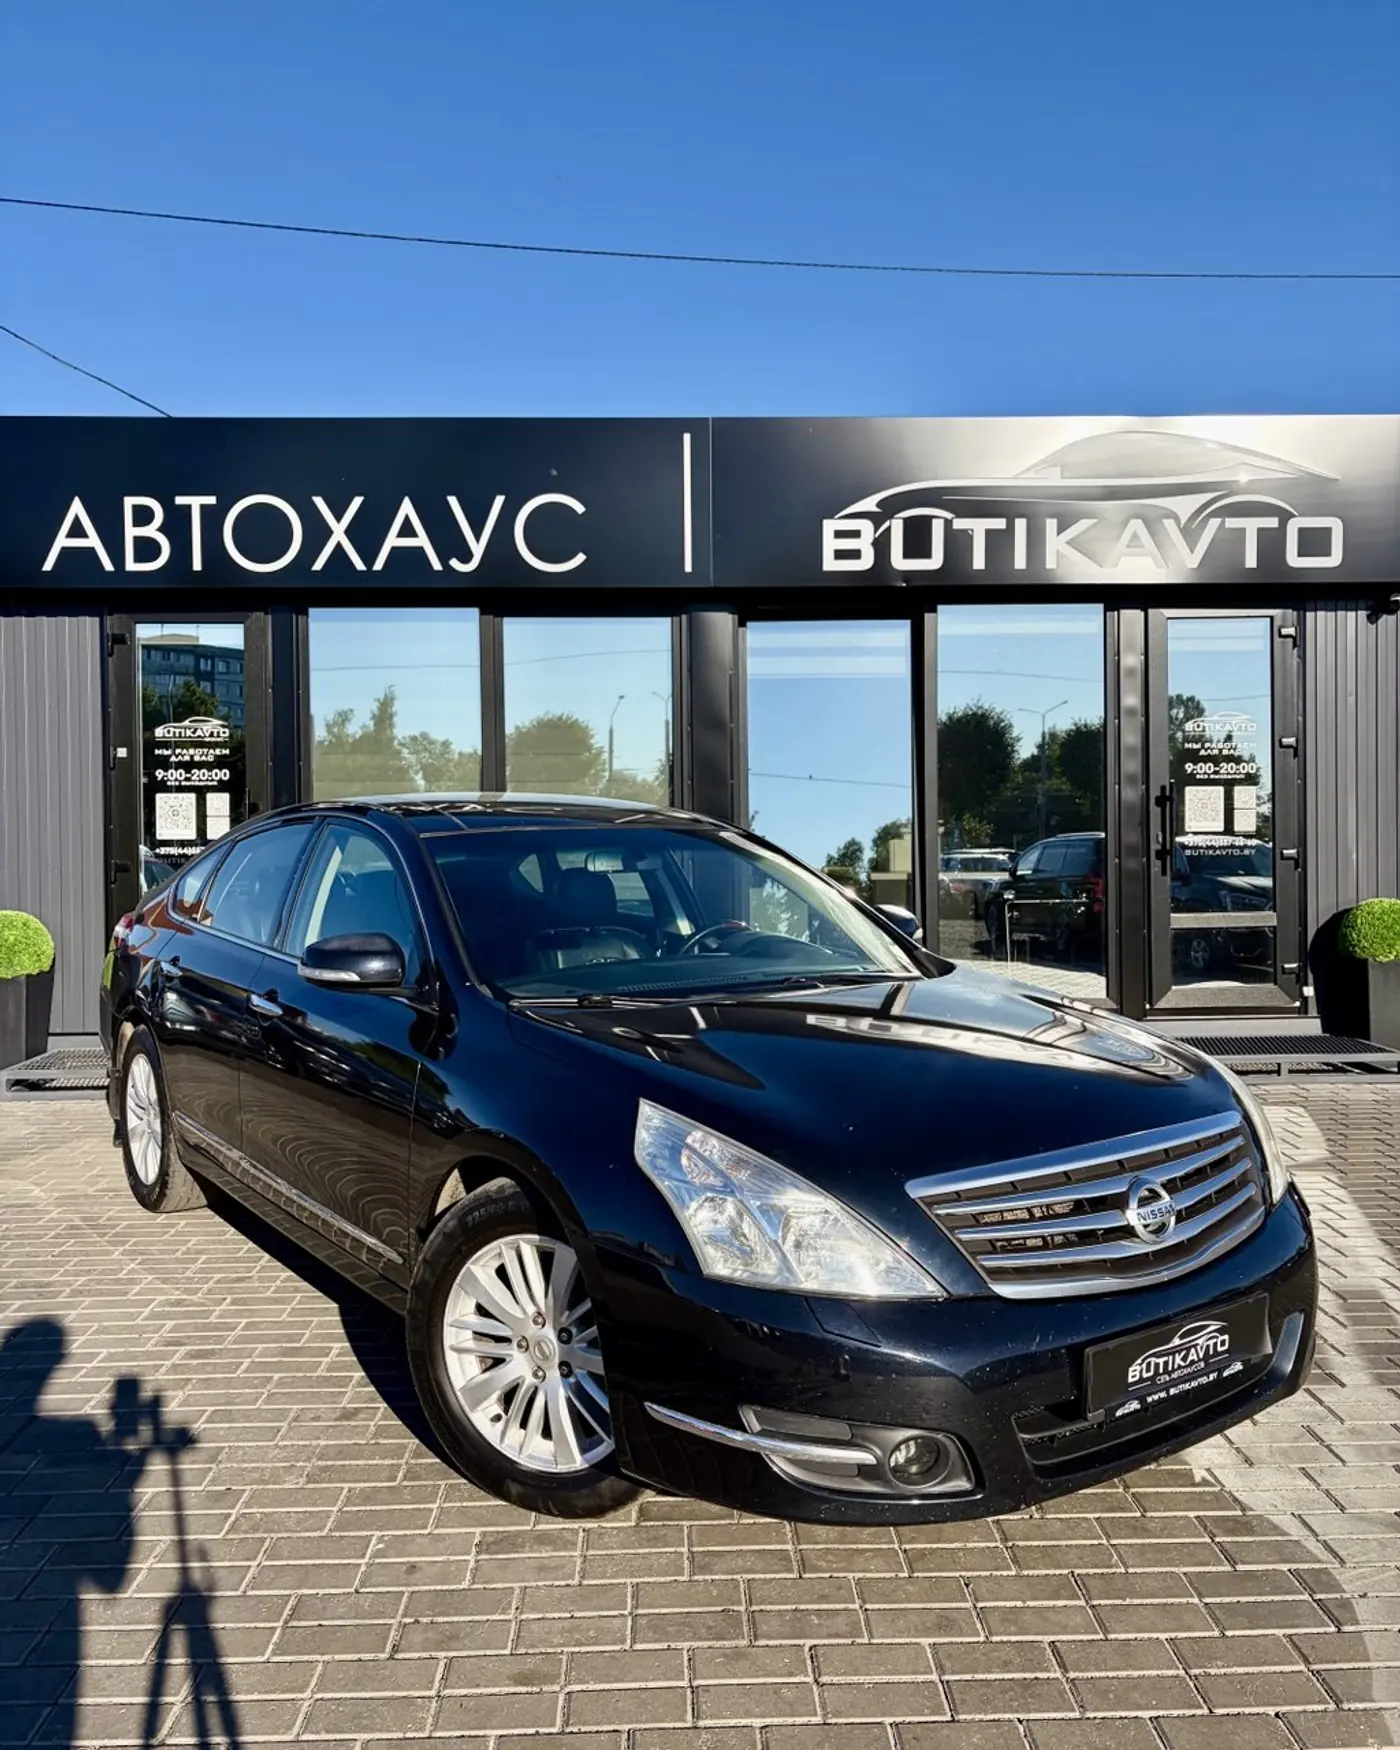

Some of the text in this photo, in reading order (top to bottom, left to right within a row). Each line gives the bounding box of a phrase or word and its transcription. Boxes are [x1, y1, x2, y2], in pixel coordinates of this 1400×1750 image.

[42, 493, 587, 573] АВТОХАУС
[821, 515, 1344, 573] BUTIKAVTO
[154, 727, 230, 737] BUTIKAVTO
[1185, 723, 1257, 732] BUTIKAVTO
[155, 768, 230, 781] 9:00-20:00
[1184, 762, 1257, 774] 9:00-20:00
[1127, 1334, 1230, 1384] BUTIKAVTO
